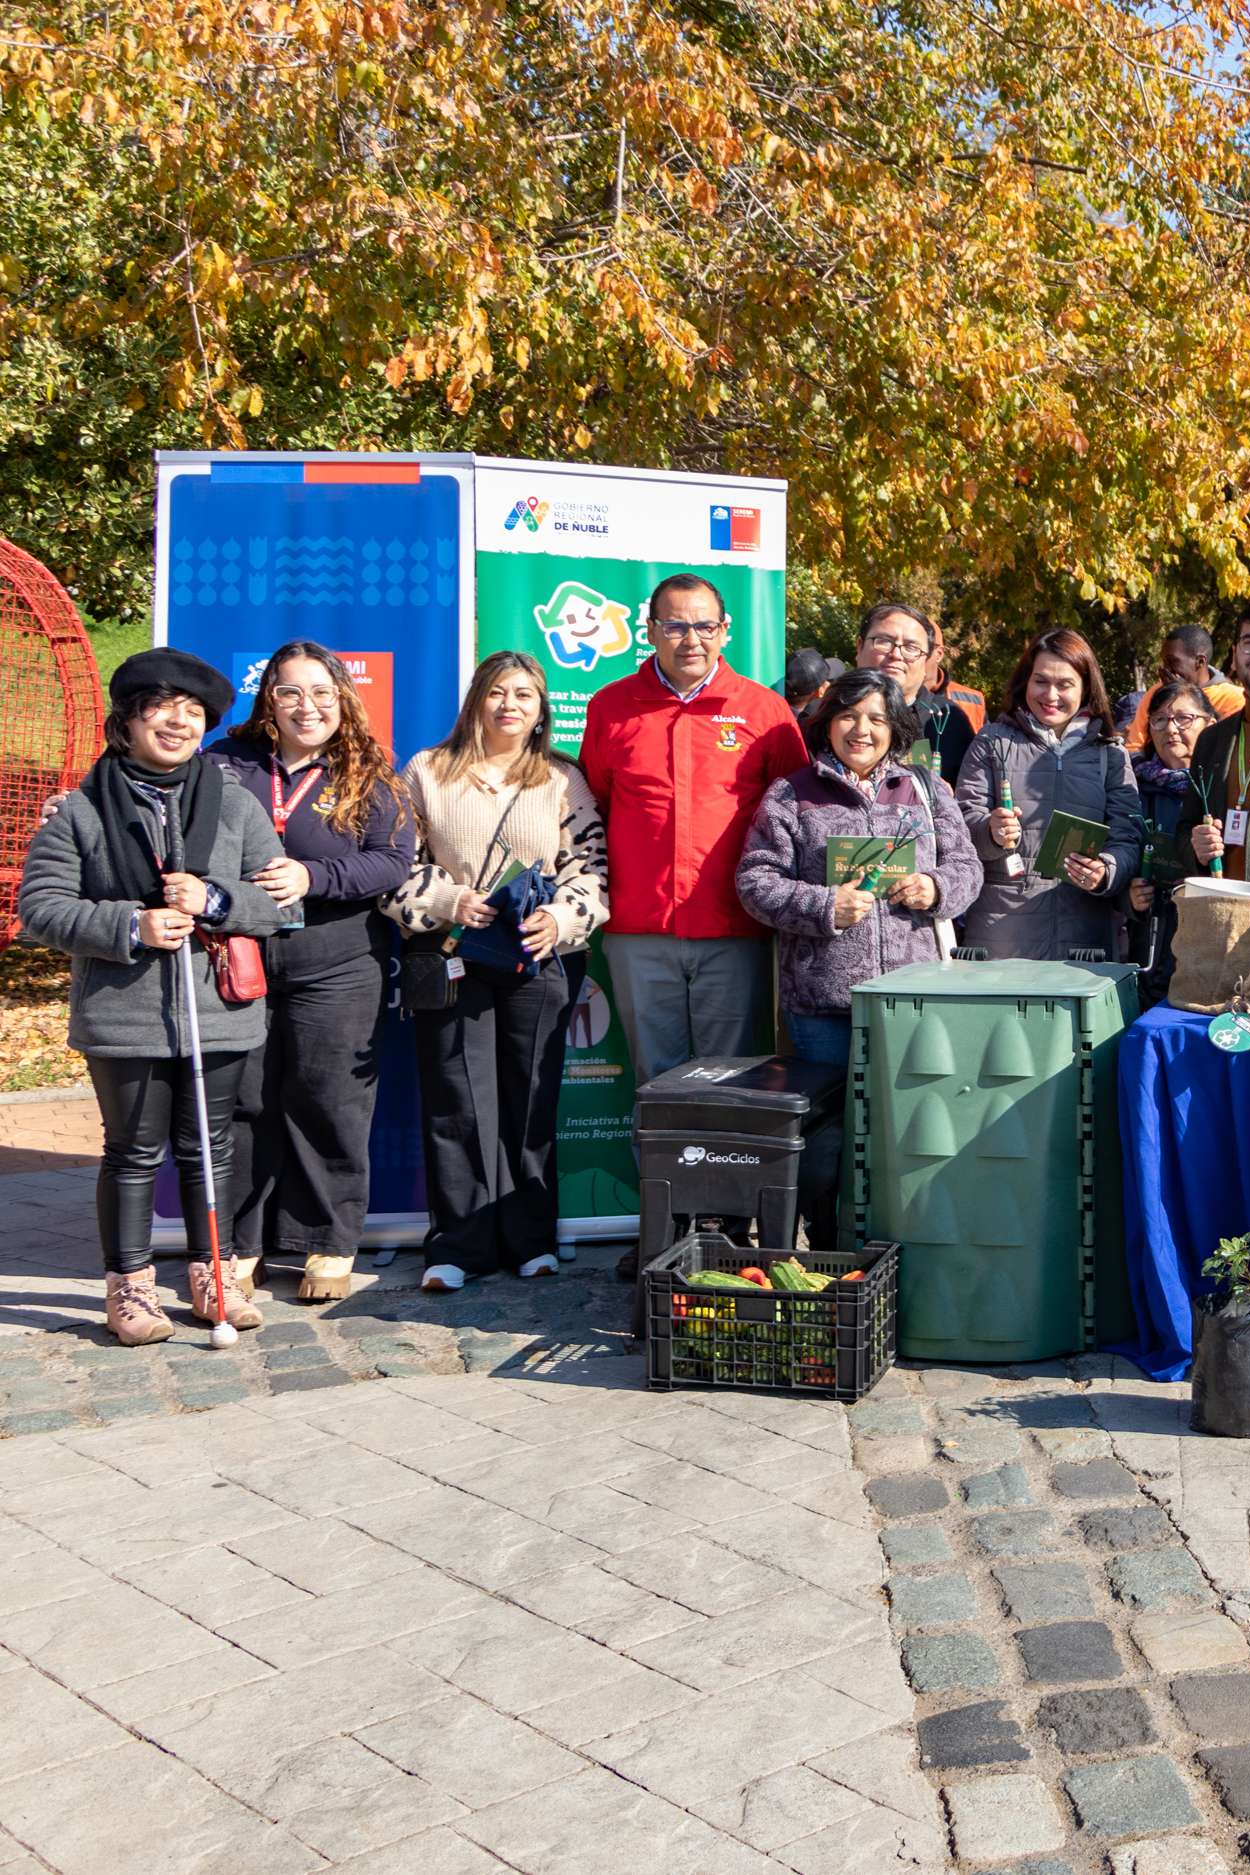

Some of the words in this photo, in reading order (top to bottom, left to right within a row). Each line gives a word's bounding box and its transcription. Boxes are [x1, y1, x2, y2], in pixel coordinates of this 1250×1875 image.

[553, 501, 609, 513] GOBIERNO
[553, 511, 609, 523] REGIONAL
[554, 522, 569, 531] DE
[572, 521, 609, 534] ÑUBLE
[635, 648, 654, 657] Rec
[548, 691, 569, 700] zar
[570, 690, 594, 701] hac
[554, 718, 588, 729] resid
[711, 714, 747, 724] Alcalde
[551, 731, 584, 744] yend
[834, 861, 865, 872] Ñuble
[564, 1057, 607, 1065] rmación
[570, 1066, 621, 1075] Monitores
[561, 1076, 615, 1085] mbientales
[566, 1116, 620, 1127] Iniciativa
[556, 1131, 590, 1140] ierno
[592, 1128, 632, 1140] Region
[706, 1152, 760, 1164] GeoCiclos
